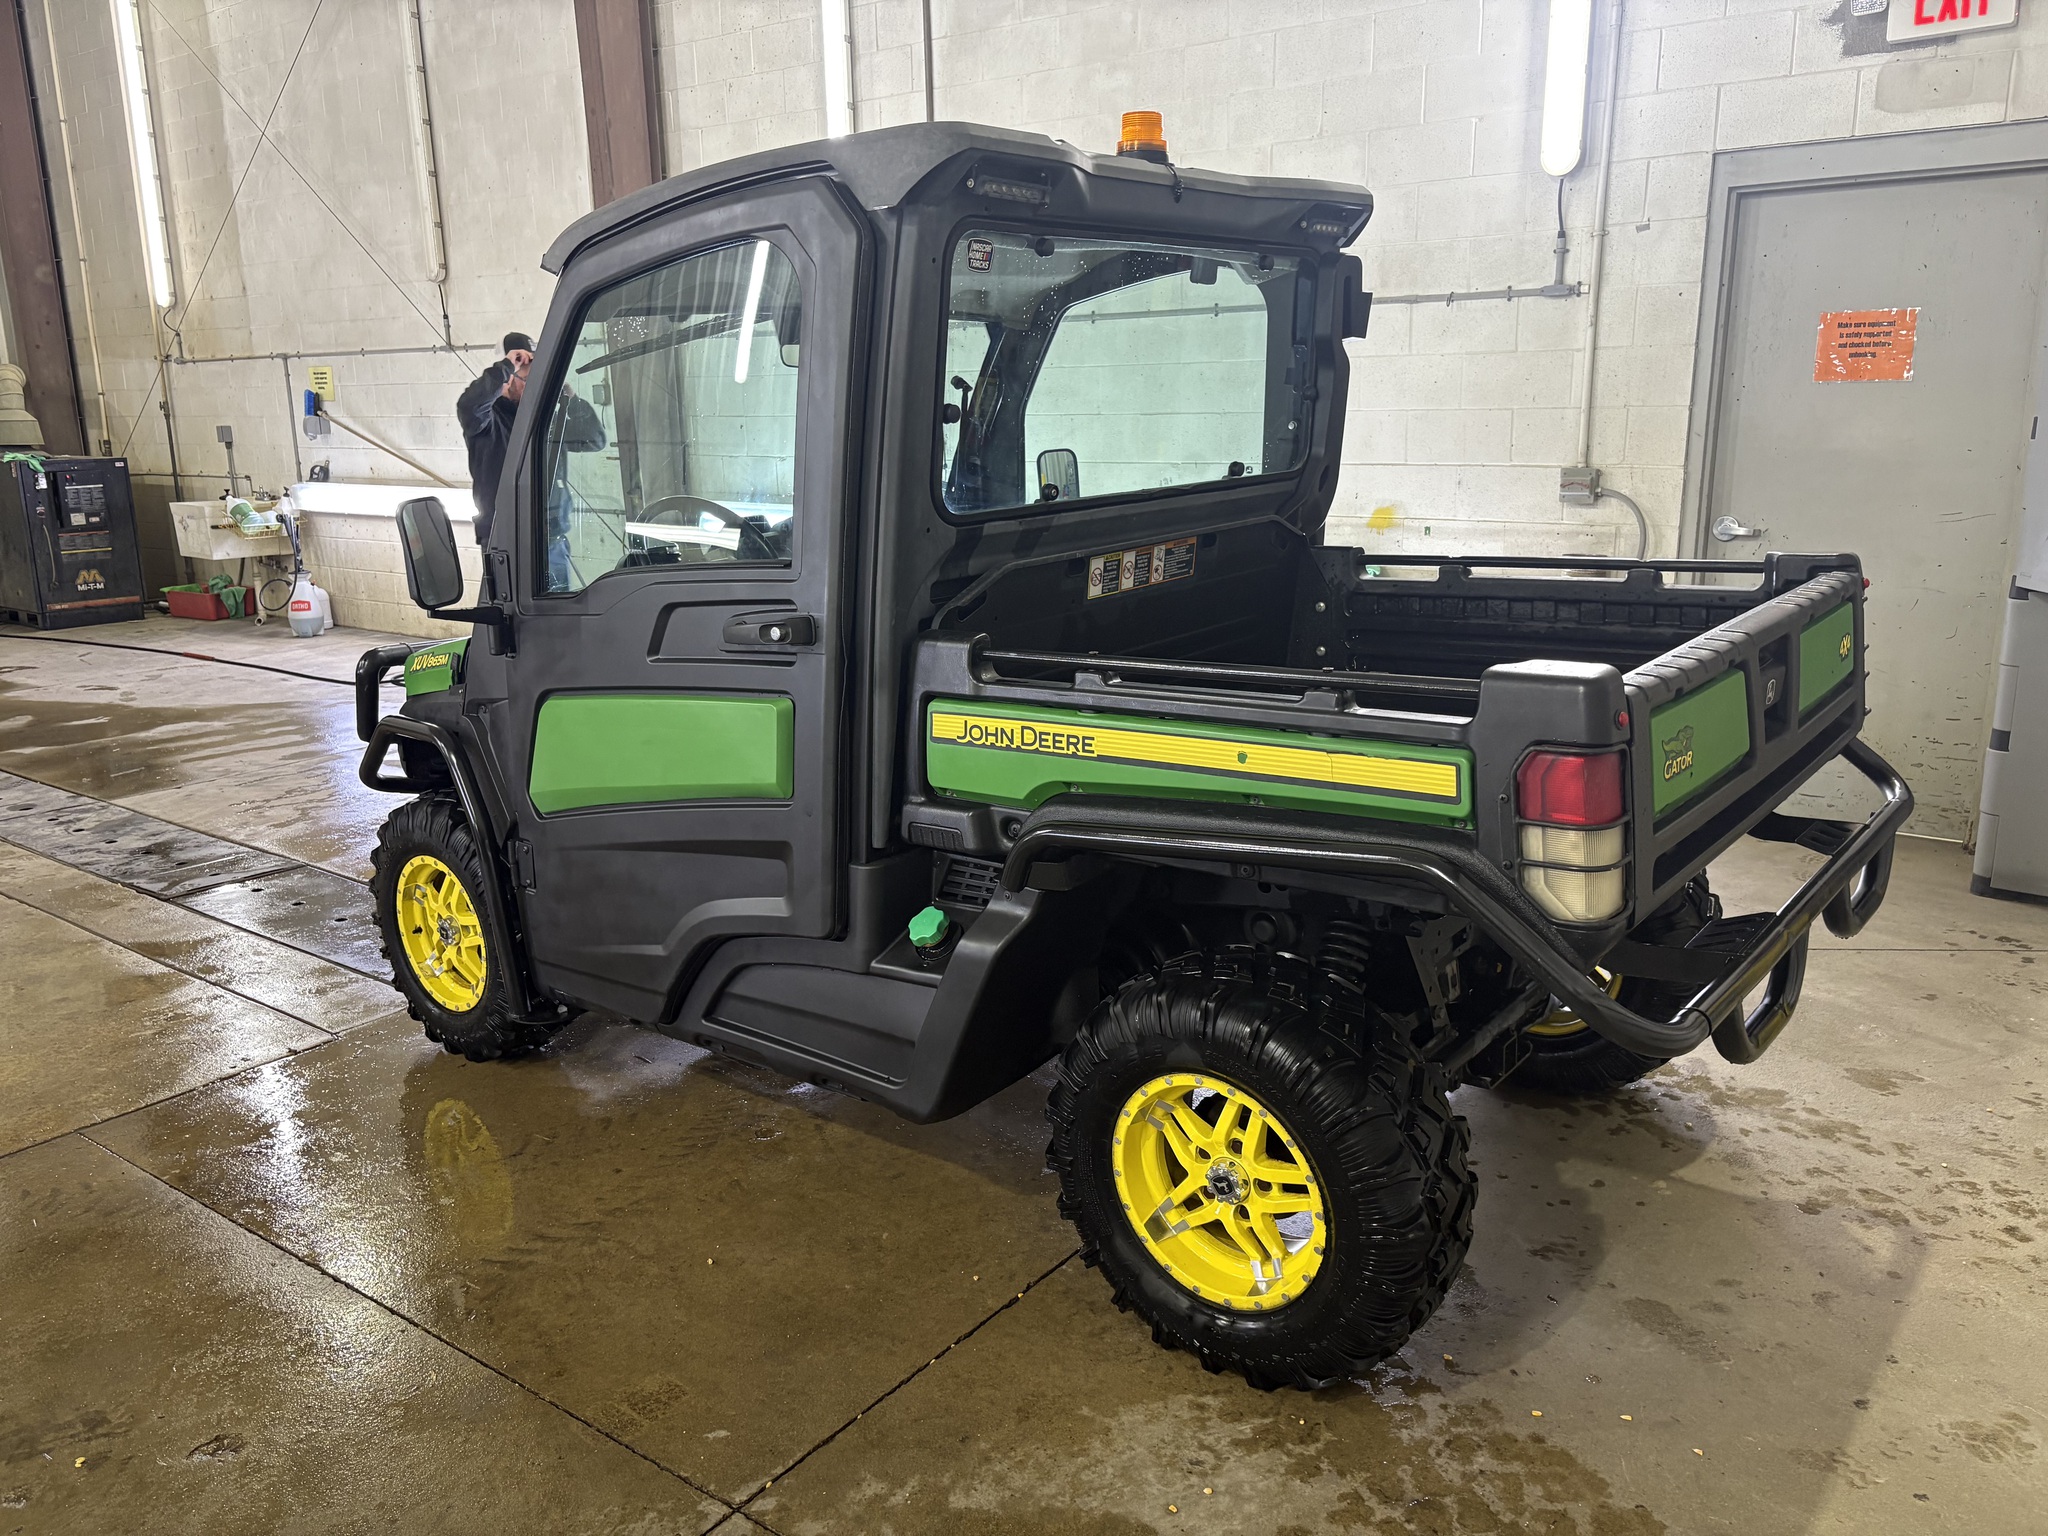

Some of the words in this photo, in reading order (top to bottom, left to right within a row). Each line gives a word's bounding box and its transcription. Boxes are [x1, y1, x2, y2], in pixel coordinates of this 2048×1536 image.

[1837, 321, 1852, 329] Make
[1845, 331, 1862, 339] safely
[957, 720, 1015, 746] JOHN
[1020, 725, 1096, 755] DEERE
[1664, 750, 1693, 779] GATOR
